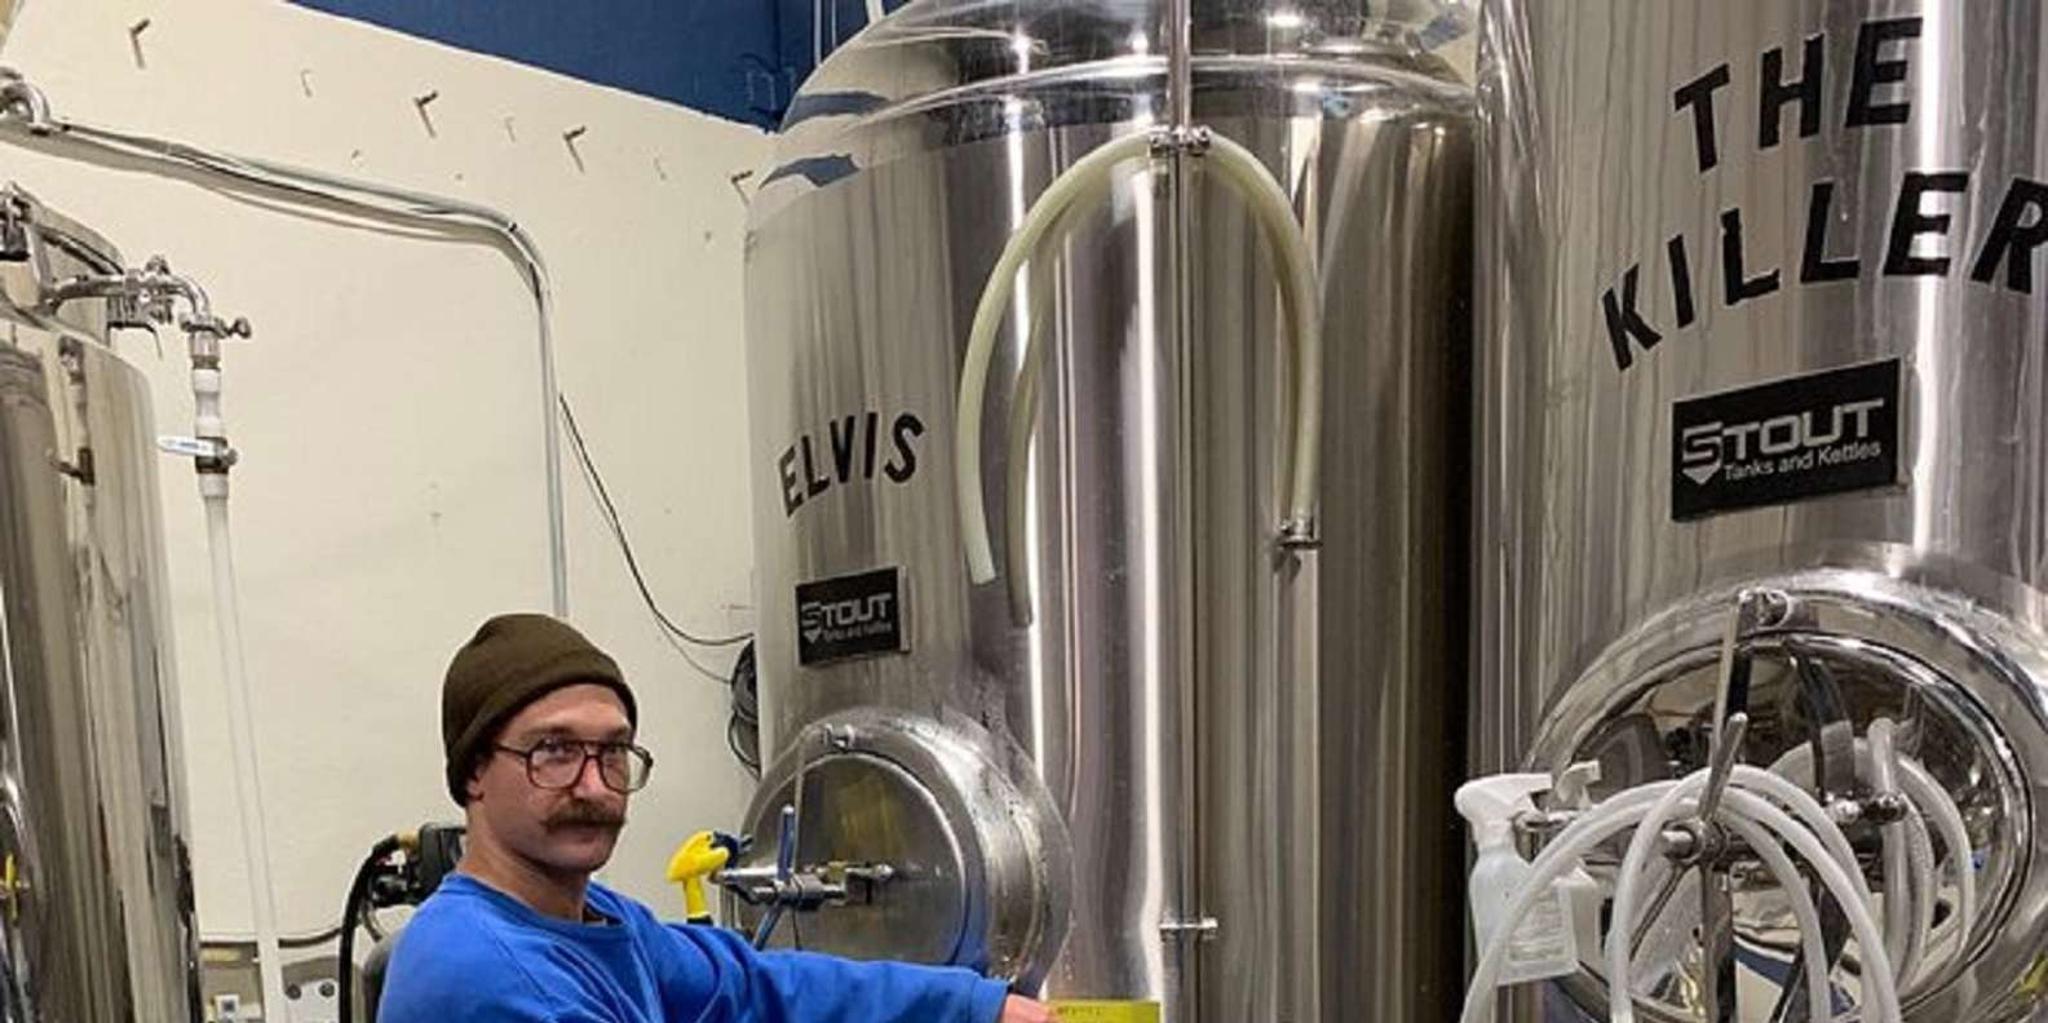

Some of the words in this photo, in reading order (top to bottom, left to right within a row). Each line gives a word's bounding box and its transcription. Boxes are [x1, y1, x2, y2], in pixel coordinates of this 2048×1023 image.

[1675, 16, 1924, 173] THE
[1602, 171, 2048, 371] KILLER
[779, 412, 924, 518] ELVIS
[1682, 398, 1885, 485] STOUT
[1724, 459, 1774, 482] Tanks
[1778, 451, 1814, 474] and
[1817, 441, 1882, 465] Kettles
[801, 592, 892, 643] STOUT
